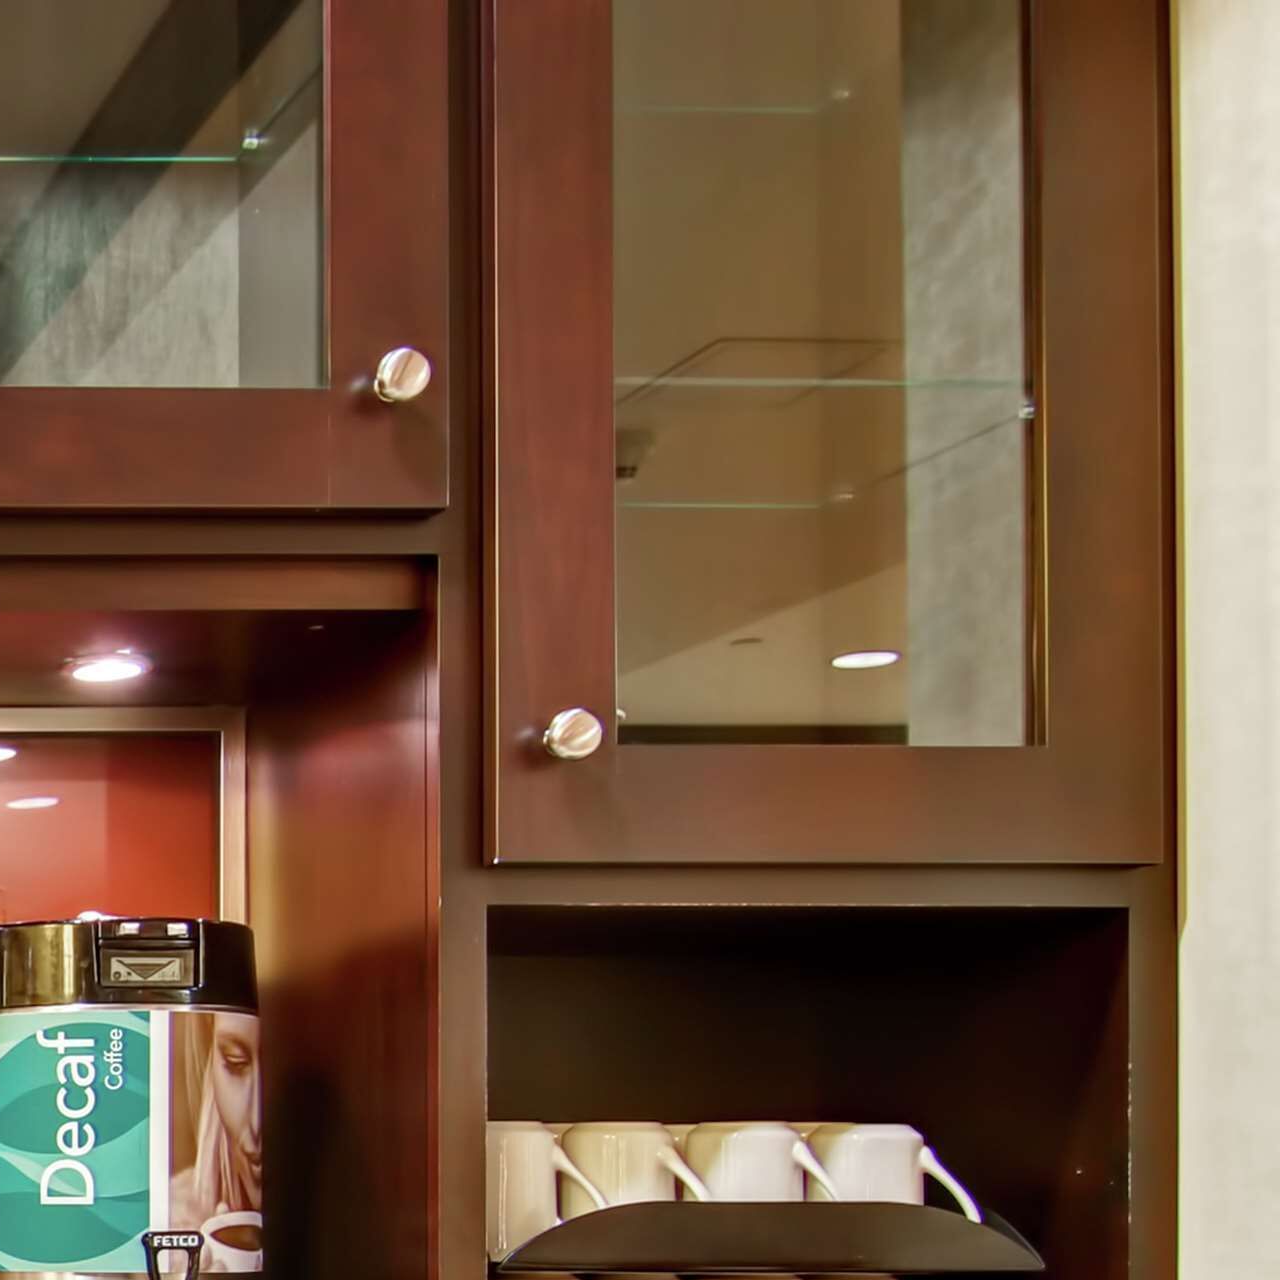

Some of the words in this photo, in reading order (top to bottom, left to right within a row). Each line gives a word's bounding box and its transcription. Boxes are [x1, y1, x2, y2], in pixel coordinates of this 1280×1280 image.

[104, 1028, 123, 1090] Coffee
[36, 1029, 96, 1205] Decaf
[153, 1235, 199, 1247] FETCO
